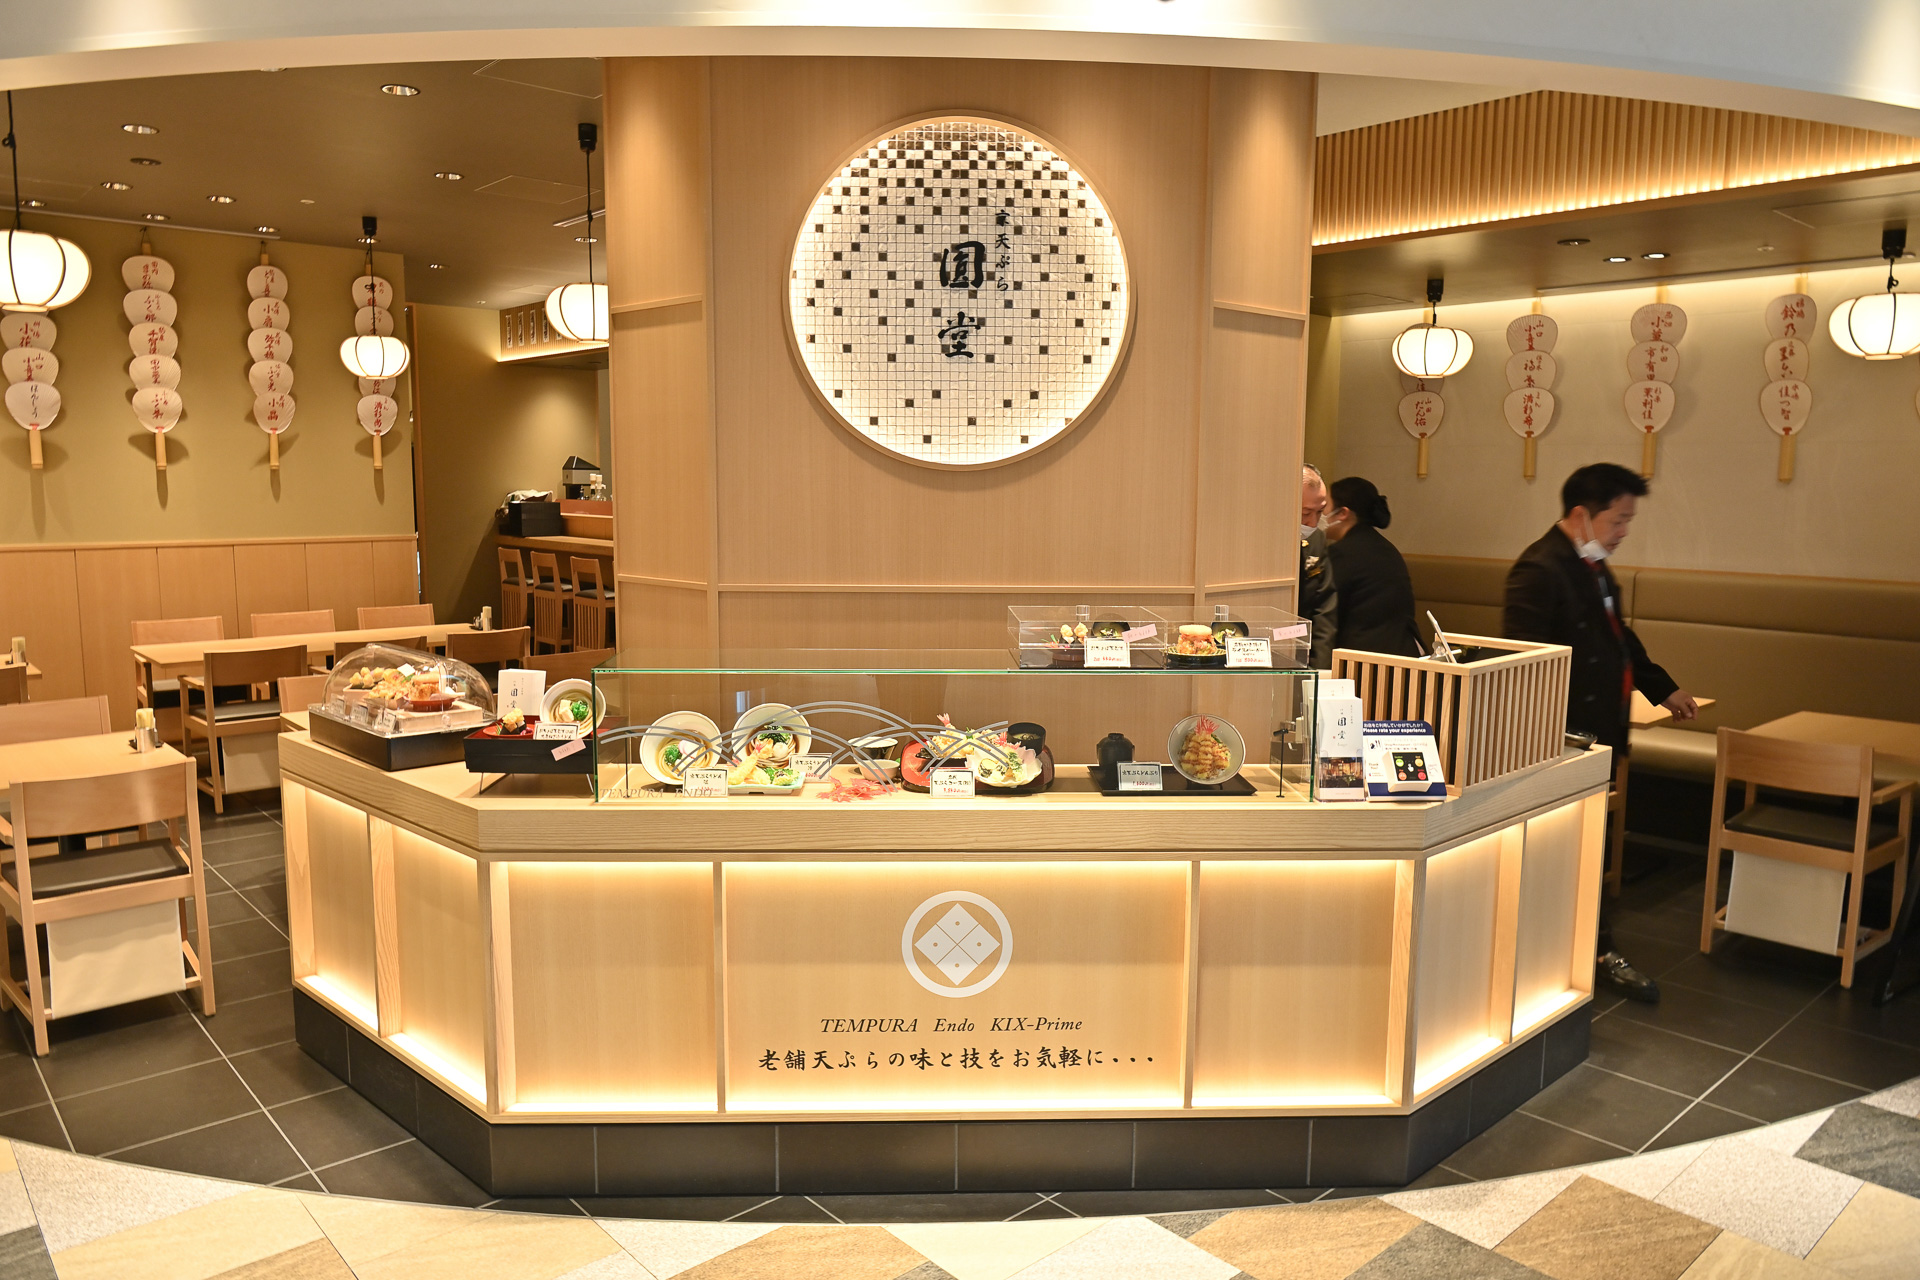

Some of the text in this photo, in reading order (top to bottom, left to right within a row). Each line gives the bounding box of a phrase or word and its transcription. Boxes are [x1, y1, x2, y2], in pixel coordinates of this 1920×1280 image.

[995, 209, 1011, 292] 京天ぷら
[938, 241, 985, 358] 圓堂
[1780, 303, 1797, 337] 鈴乃
[600, 788, 664, 798] TEMPURA
[674, 787, 713, 798] ENDO
[820, 1016, 1083, 1033] TEMPURA Endo KIX-Prime
